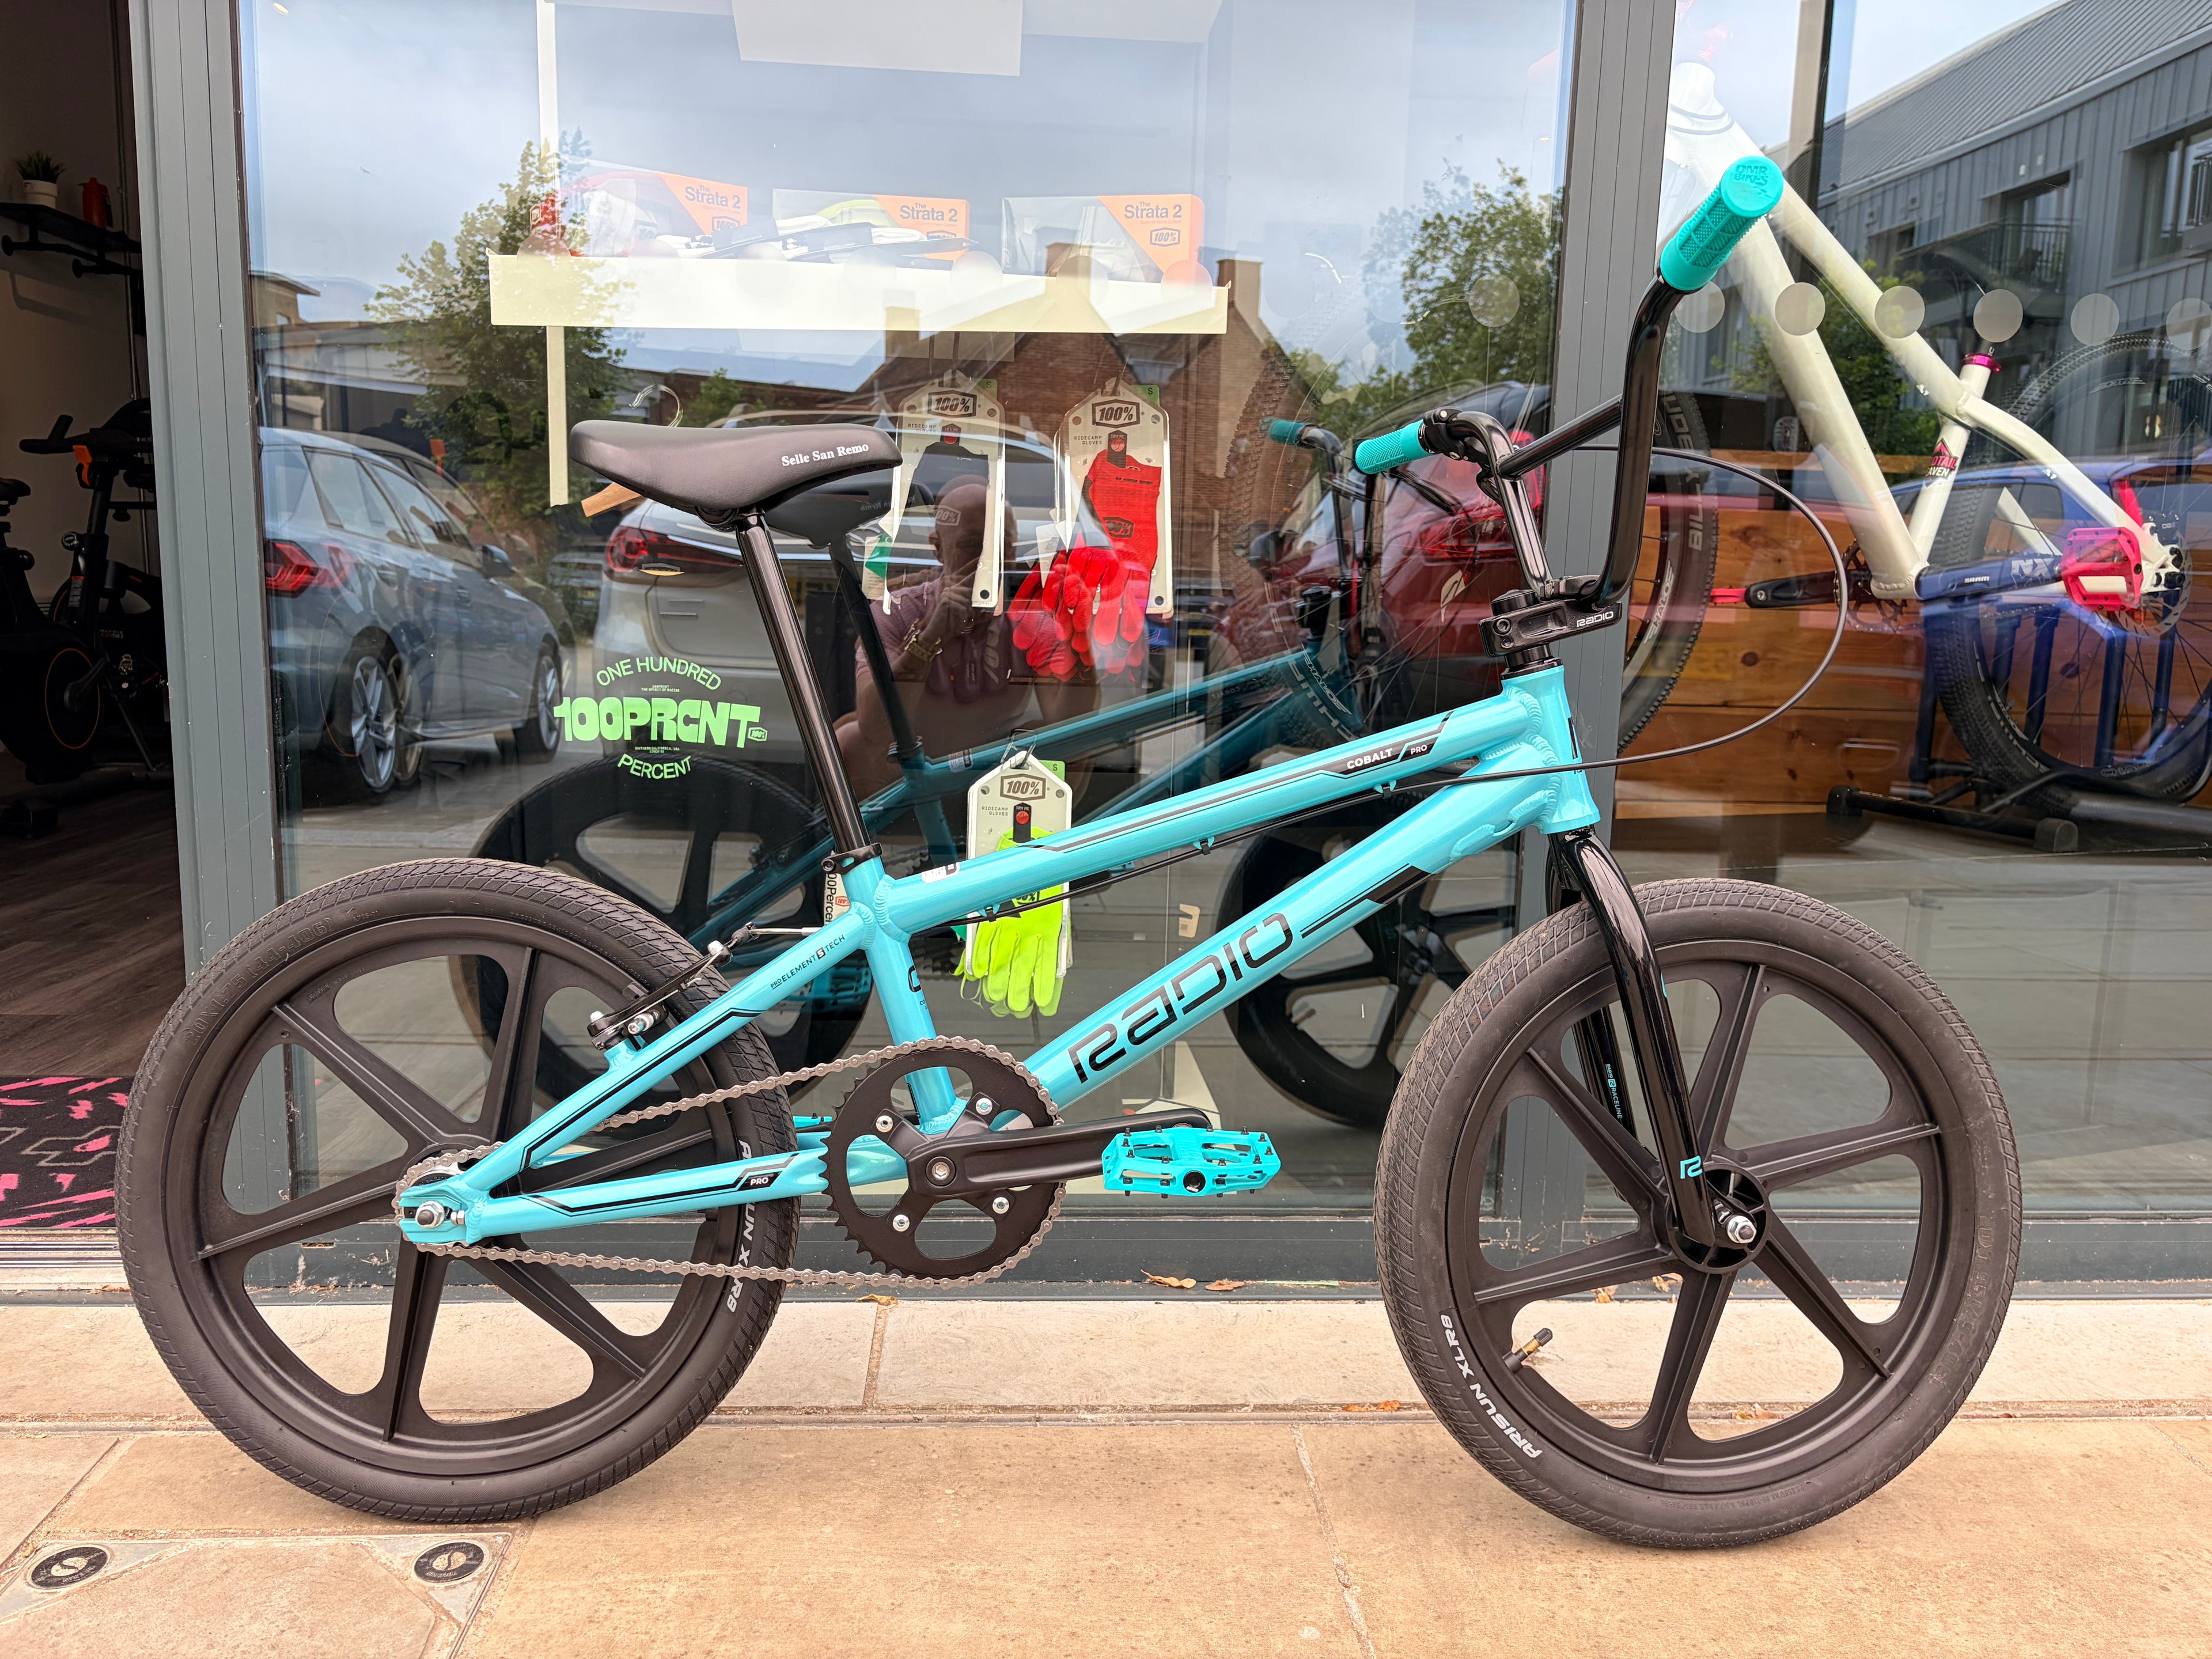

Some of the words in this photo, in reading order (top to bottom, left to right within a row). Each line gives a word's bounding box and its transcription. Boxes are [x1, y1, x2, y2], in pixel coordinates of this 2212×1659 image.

[1735, 164, 1768, 176] DMR
[1734, 173, 1768, 187] BIKES
[685, 186, 728, 207] Strata
[732, 195, 741, 209] 2
[900, 205, 944, 221] Strata
[949, 209, 957, 222] 2
[1124, 204, 1168, 219] Strata
[1173, 204, 1182, 218] 2
[1154, 232, 1176, 242] 100%
[935, 397, 971, 413] 100%
[1099, 407, 1134, 422] 100%
[781, 453, 810, 467] Selle
[812, 450, 835, 461] San
[836, 444, 869, 457] Remo
[1683, 465, 1703, 551] BILLY
[2011, 558, 2055, 579] NX
[1964, 575, 1990, 584] SRAM
[596, 658, 634, 687] ONE
[635, 656, 721, 691] HUNDRED
[554, 696, 761, 748] 100PRCNT
[751, 730, 766, 740] 100%
[618, 753, 692, 779] PERCENT
[1347, 748, 1393, 770] COBALT
[1411, 745, 1427, 755] PRO
[1006, 781, 1040, 795] 100%
[771, 978, 782, 988] PRO
[781, 955, 816, 982] ELEMENT
[824, 934, 845, 952] TECH
[1611, 1087, 1623, 1119] RACELINE
[751, 1177, 769, 1185] PRO
[1469, 1383, 1543, 1459] ARISUN
